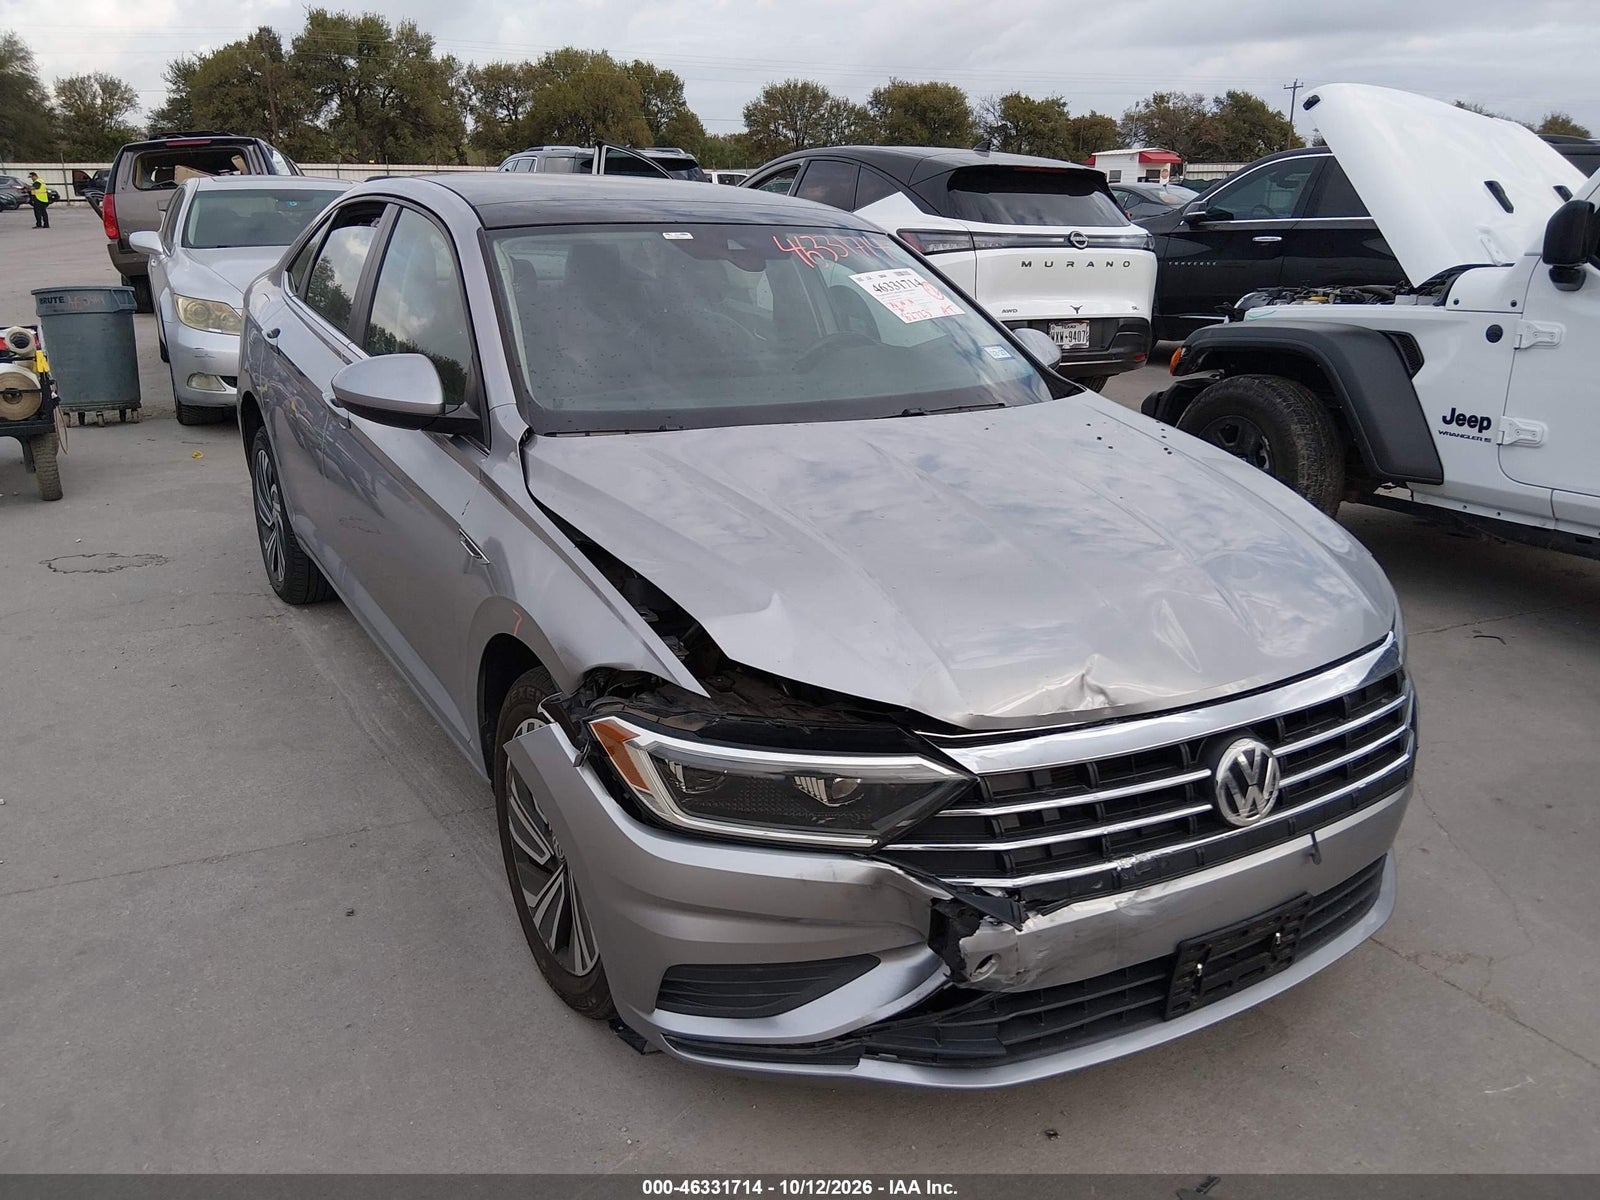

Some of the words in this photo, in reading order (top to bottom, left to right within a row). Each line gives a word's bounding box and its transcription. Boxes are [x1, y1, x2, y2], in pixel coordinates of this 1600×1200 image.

[1021, 260, 1131, 268] MURANO
[872, 279, 923, 293] 46331714
[39, 295, 65, 305] BRUTE
[1442, 407, 1492, 433] Jeep
[1438, 429, 1482, 441] WRANGLER
